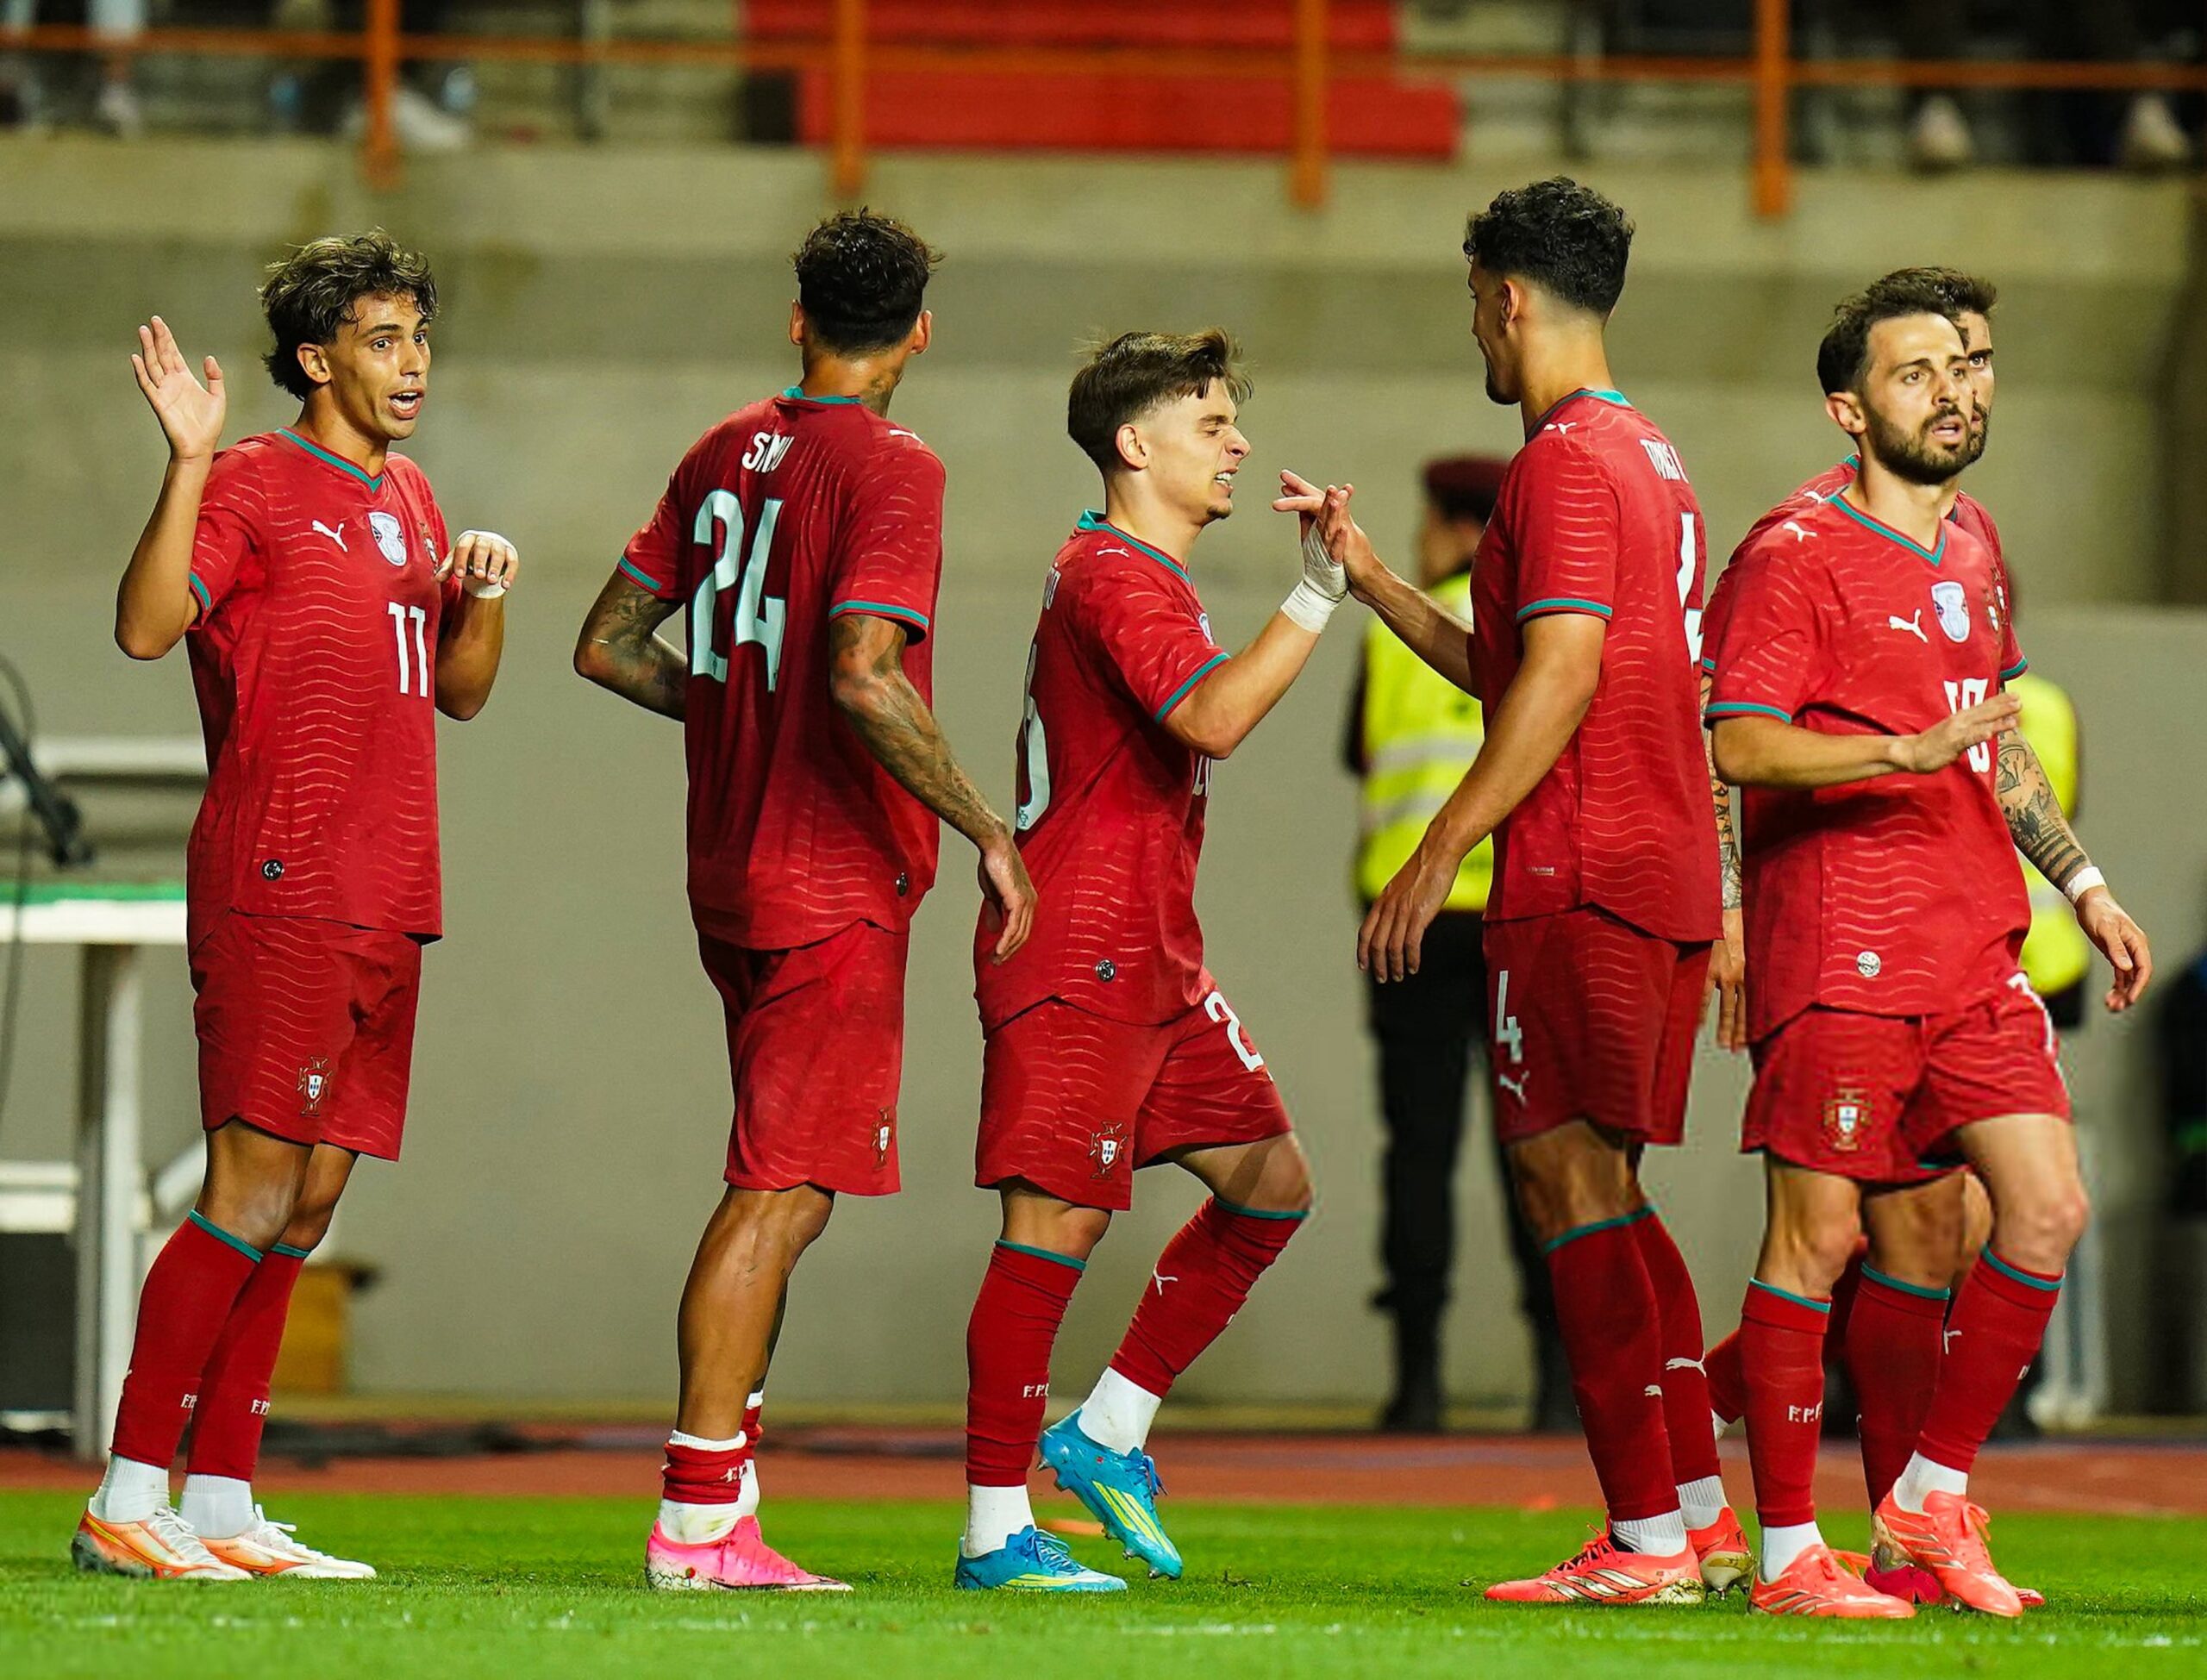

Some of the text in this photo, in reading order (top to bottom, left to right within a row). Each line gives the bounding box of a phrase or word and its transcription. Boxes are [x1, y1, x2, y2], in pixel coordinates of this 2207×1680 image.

[691, 489, 785, 692] 24
[387, 602, 428, 697] 11
[1204, 991, 1264, 1072] 2
[1497, 970, 1522, 1063] 4
